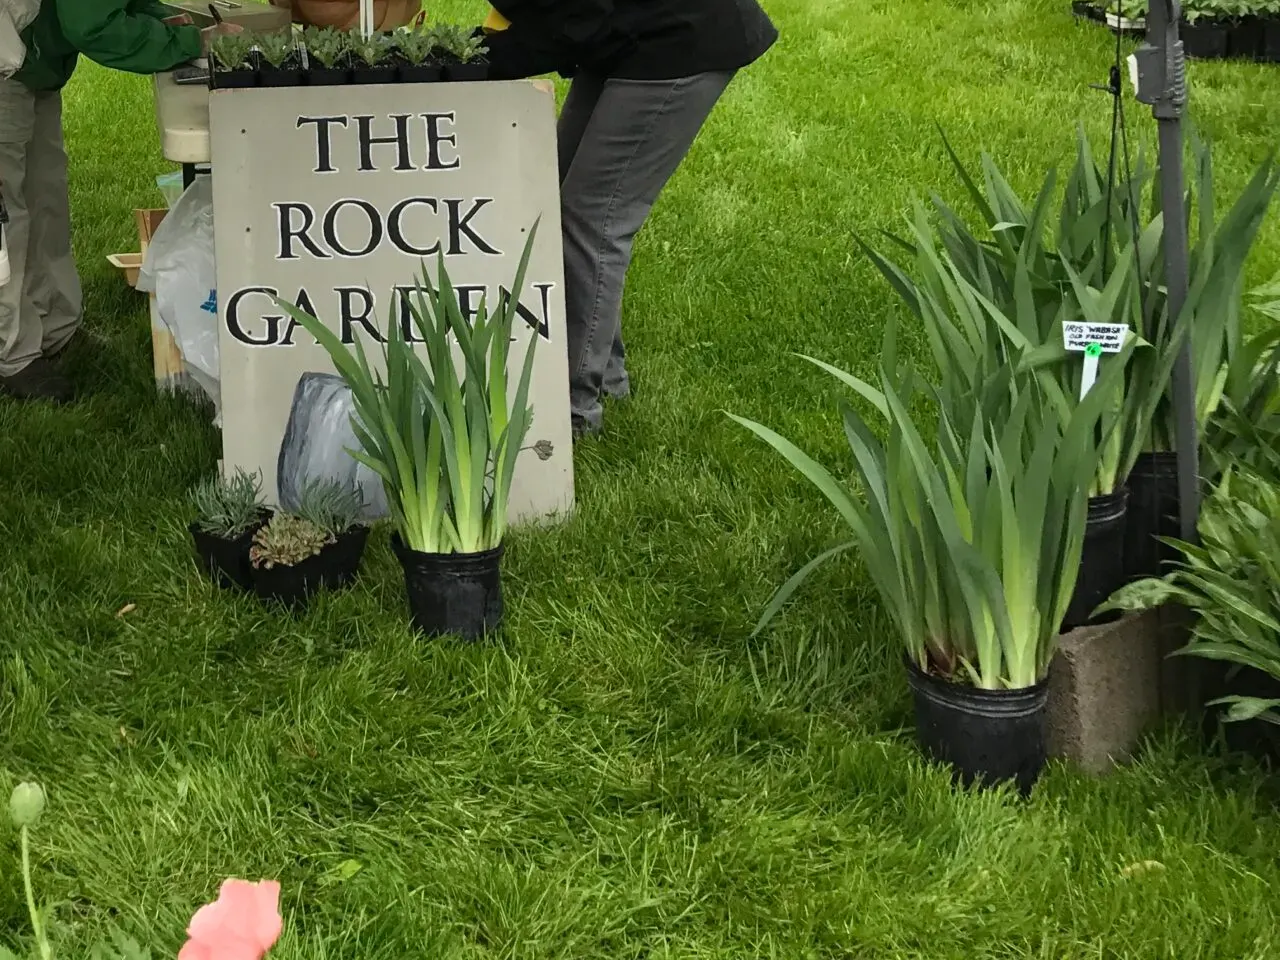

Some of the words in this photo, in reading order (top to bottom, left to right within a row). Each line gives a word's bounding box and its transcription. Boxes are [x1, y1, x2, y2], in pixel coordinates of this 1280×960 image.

[296, 111, 461, 173] THE
[271, 197, 505, 260] ROCK
[1065, 324, 1083, 333] IRIS
